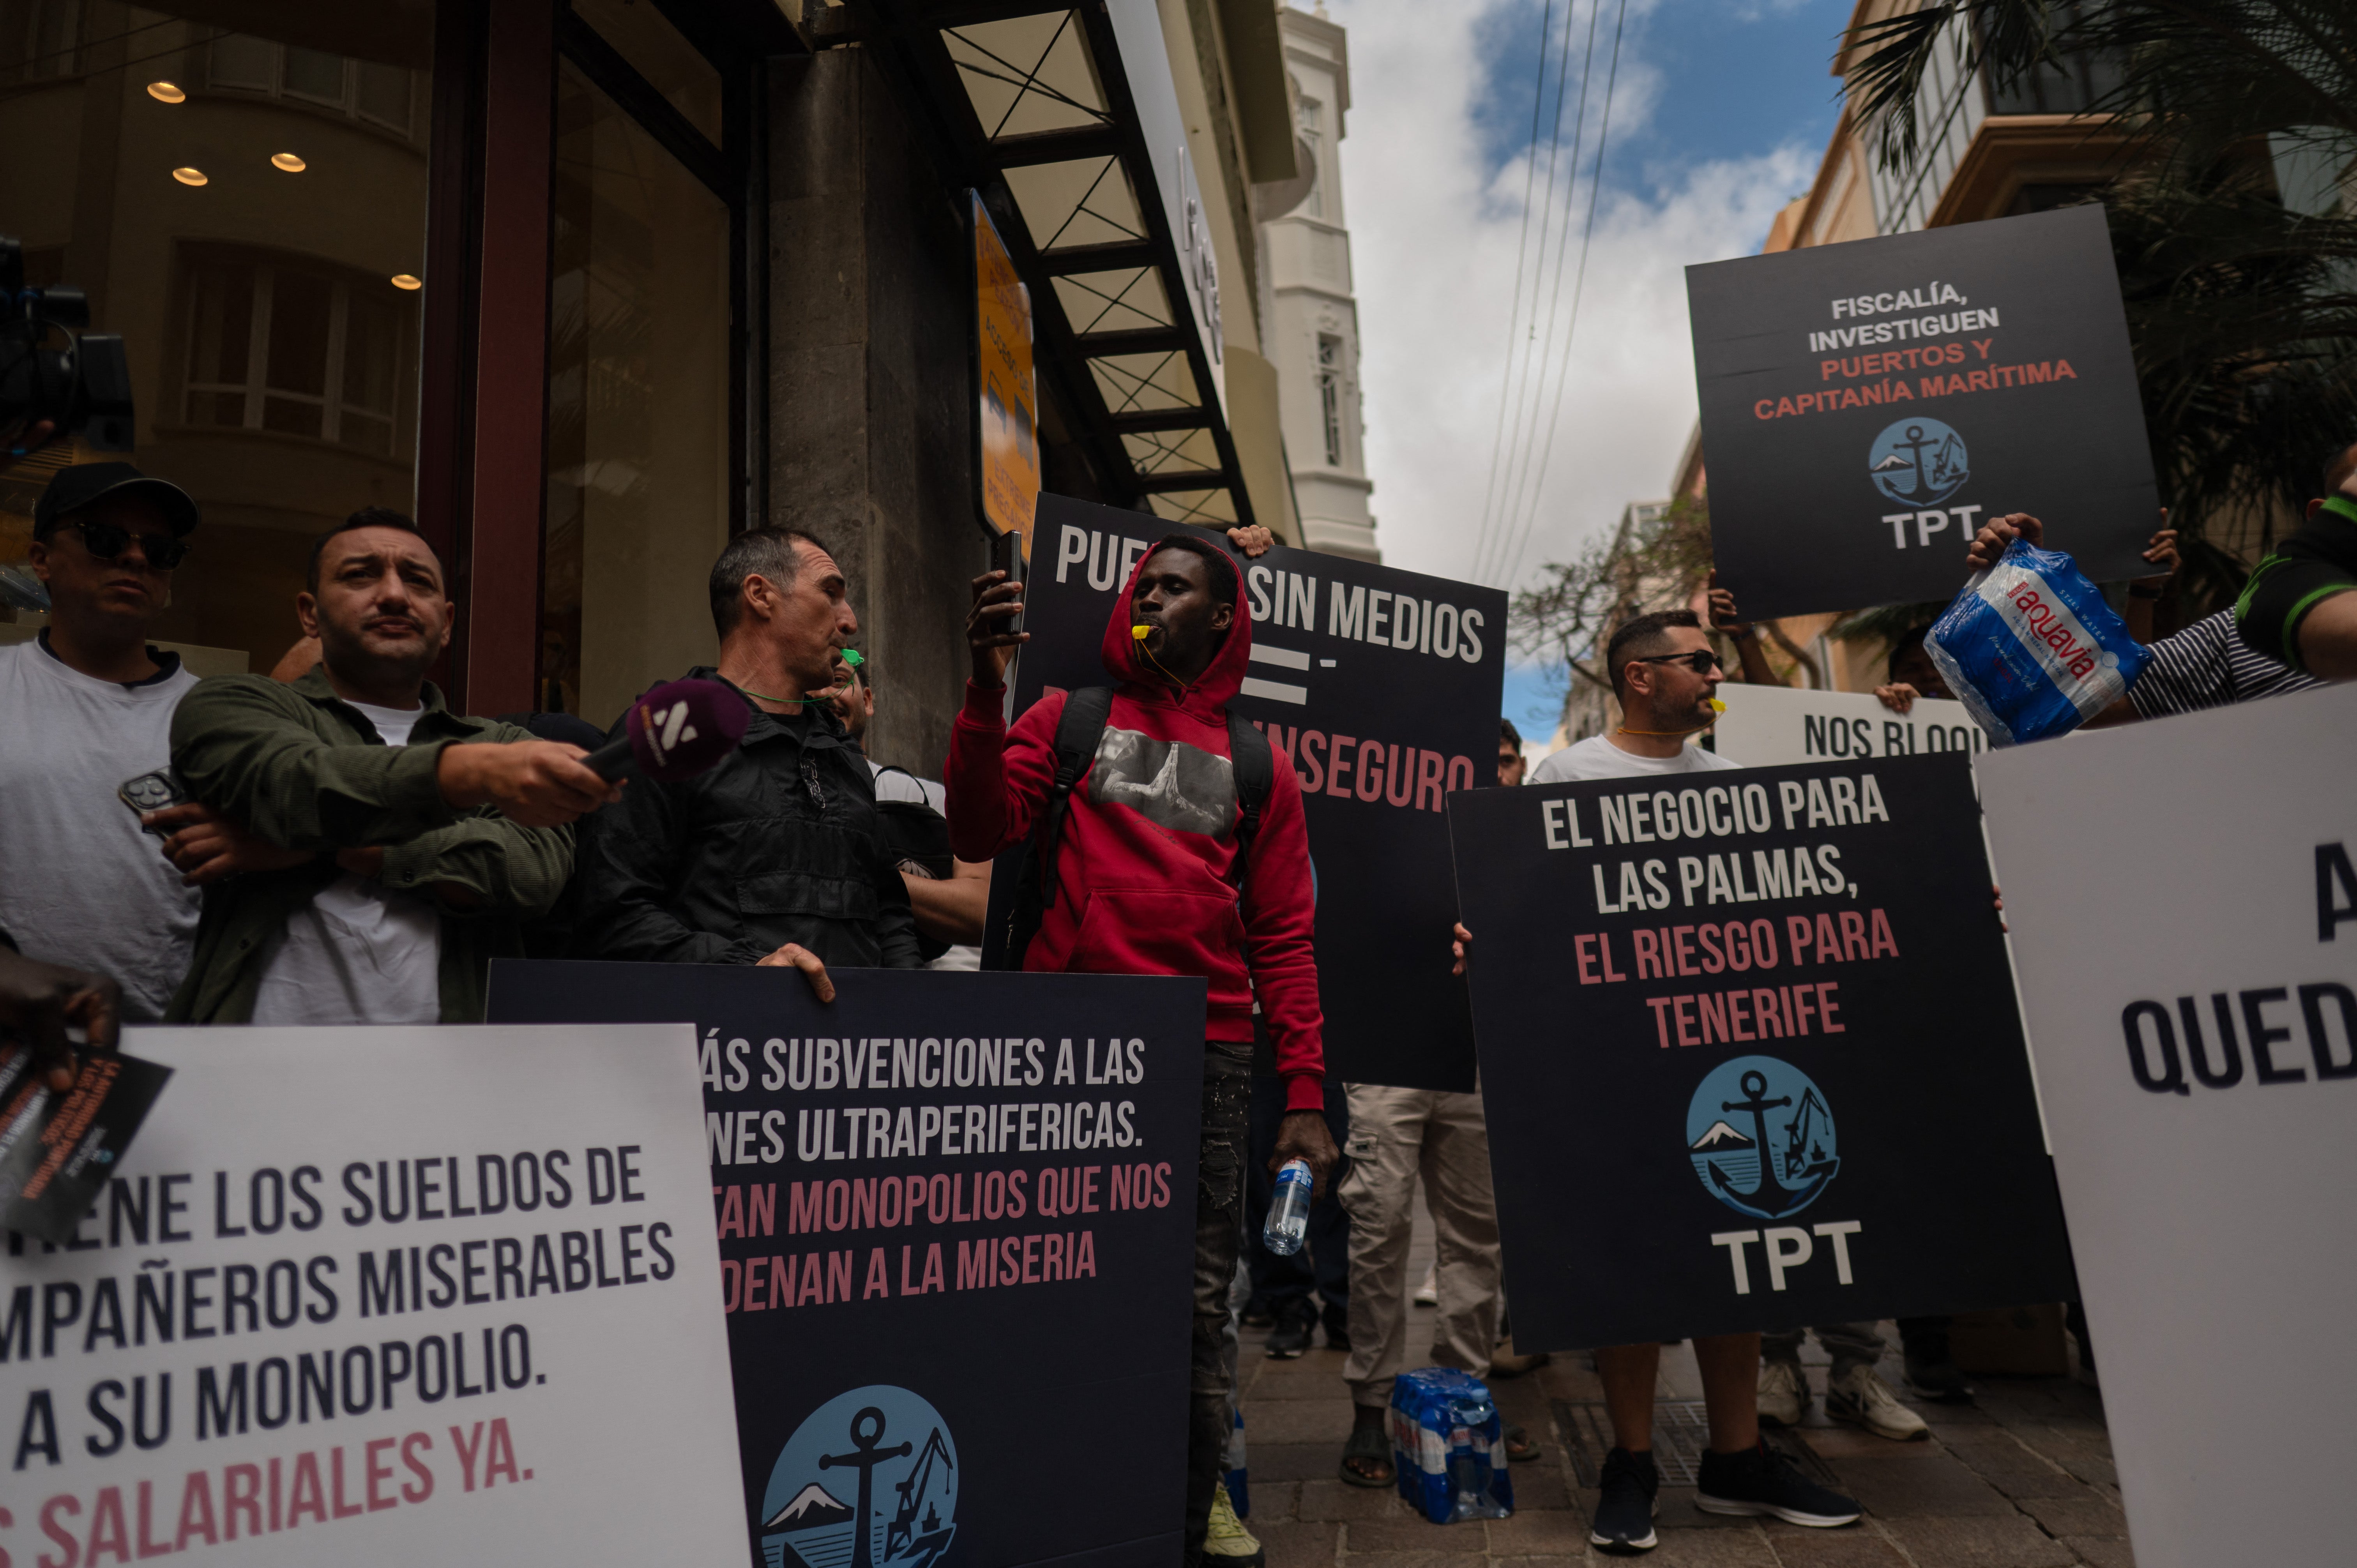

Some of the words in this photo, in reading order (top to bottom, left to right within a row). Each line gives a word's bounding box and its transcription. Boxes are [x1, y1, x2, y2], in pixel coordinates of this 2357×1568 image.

[1809, 307, 1999, 352] INVESTIGUEN
[1832, 281, 1968, 320] FISCALÍA,
[1754, 378, 1914, 419] CAPITANÍA
[1921, 359, 2077, 398] MARÍTIMA
[1822, 344, 1965, 380] PUERTOS
[1971, 338, 1993, 359] Y
[1882, 505, 1982, 549] TPT
[1056, 524, 1156, 595] PUE
[1248, 565, 1316, 631] SIN
[1329, 581, 1484, 663] MEDIOS
[2082, 613, 2106, 641] WATER
[2012, 615, 2026, 630] AGUA
[2025, 630, 2045, 655] MINERAL
[2044, 653, 2064, 678] NATURAL
[1253, 721, 1475, 812] NSEGURO
[1805, 715, 1873, 759] NOS
[1542, 799, 1593, 849] EL
[1599, 784, 1771, 845] NEGOCIO
[1781, 774, 1889, 830] PARA
[1593, 859, 1670, 914] LAS
[1680, 844, 1858, 907] PALMAS,
[1574, 933, 1626, 984] EL
[1633, 919, 1778, 980] RIESGO
[1787, 908, 1898, 966] PARA
[1646, 982, 1845, 1048] TENERIFE
[762, 1038, 1044, 1091] SUBVENCIONES
[1053, 1038, 1075, 1085] A
[1086, 1038, 1145, 1084] LAS
[797, 1100, 1143, 1161] ULTRAPERIFERICAS.
[214, 1165, 323, 1239] LOS
[341, 1150, 572, 1227] SUELDOS
[586, 1145, 645, 1206] DE
[789, 1169, 1027, 1234] MONOPOLIOS
[1037, 1166, 1101, 1218] QUE
[1110, 1162, 1171, 1211] NOS
[358, 1221, 675, 1318] MISERABLES
[863, 1247, 889, 1300] A
[901, 1243, 944, 1296] LA
[956, 1231, 1095, 1291] MISERIA
[1711, 1220, 1861, 1294] TPT
[13, 1388, 61, 1470] A
[85, 1373, 171, 1458] SU
[195, 1323, 546, 1441] MONOPOLIO.
[38, 1431, 433, 1568] SALARIALES
[449, 1418, 533, 1493] YA.
